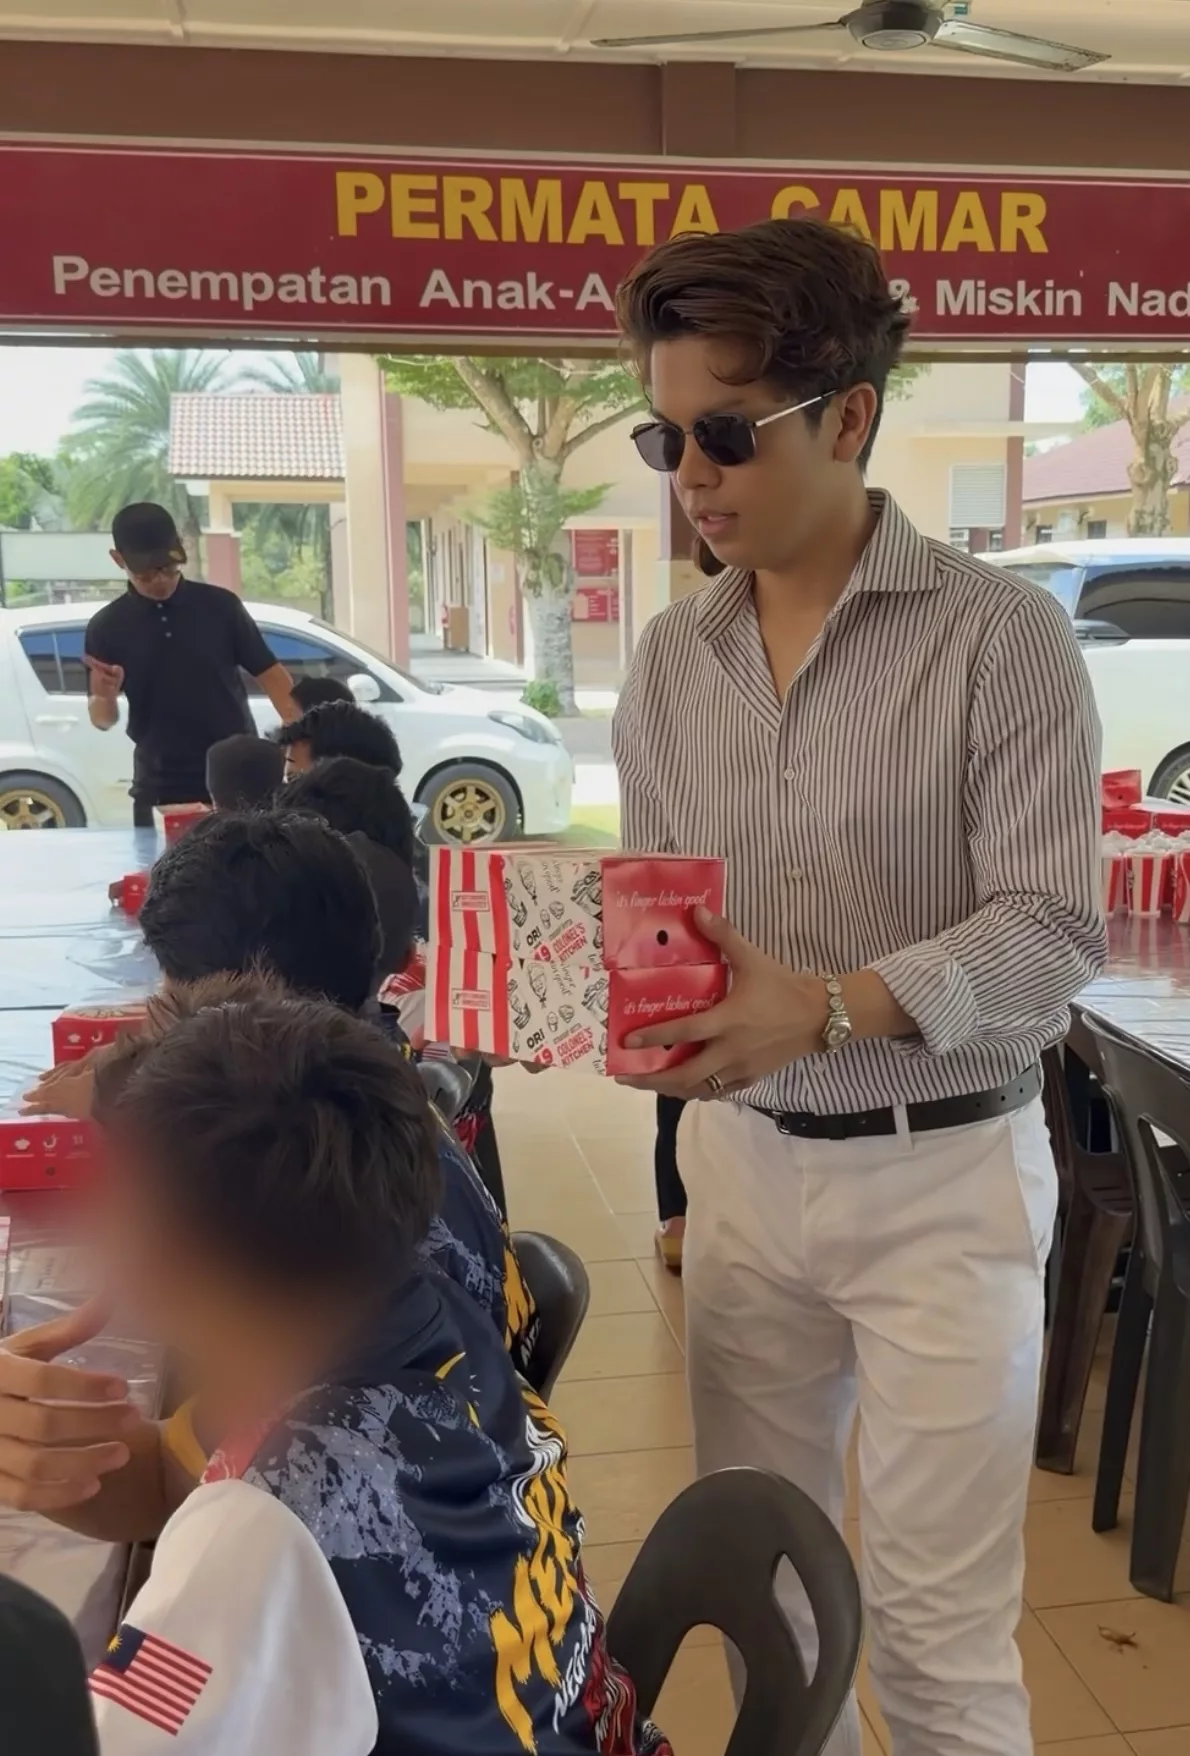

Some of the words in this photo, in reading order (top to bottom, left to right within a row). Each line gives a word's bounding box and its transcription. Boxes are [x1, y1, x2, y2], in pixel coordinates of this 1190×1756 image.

[335, 171, 721, 246] PERMATA
[771, 185, 1049, 253] CAMAR
[52, 255, 391, 310] Penempatan
[419, 268, 618, 311] Anak-A
[936, 279, 1082, 317] Miskin
[559, 936, 588, 963] KITCHEN
[561, 1040, 594, 1068] KITCHEN
